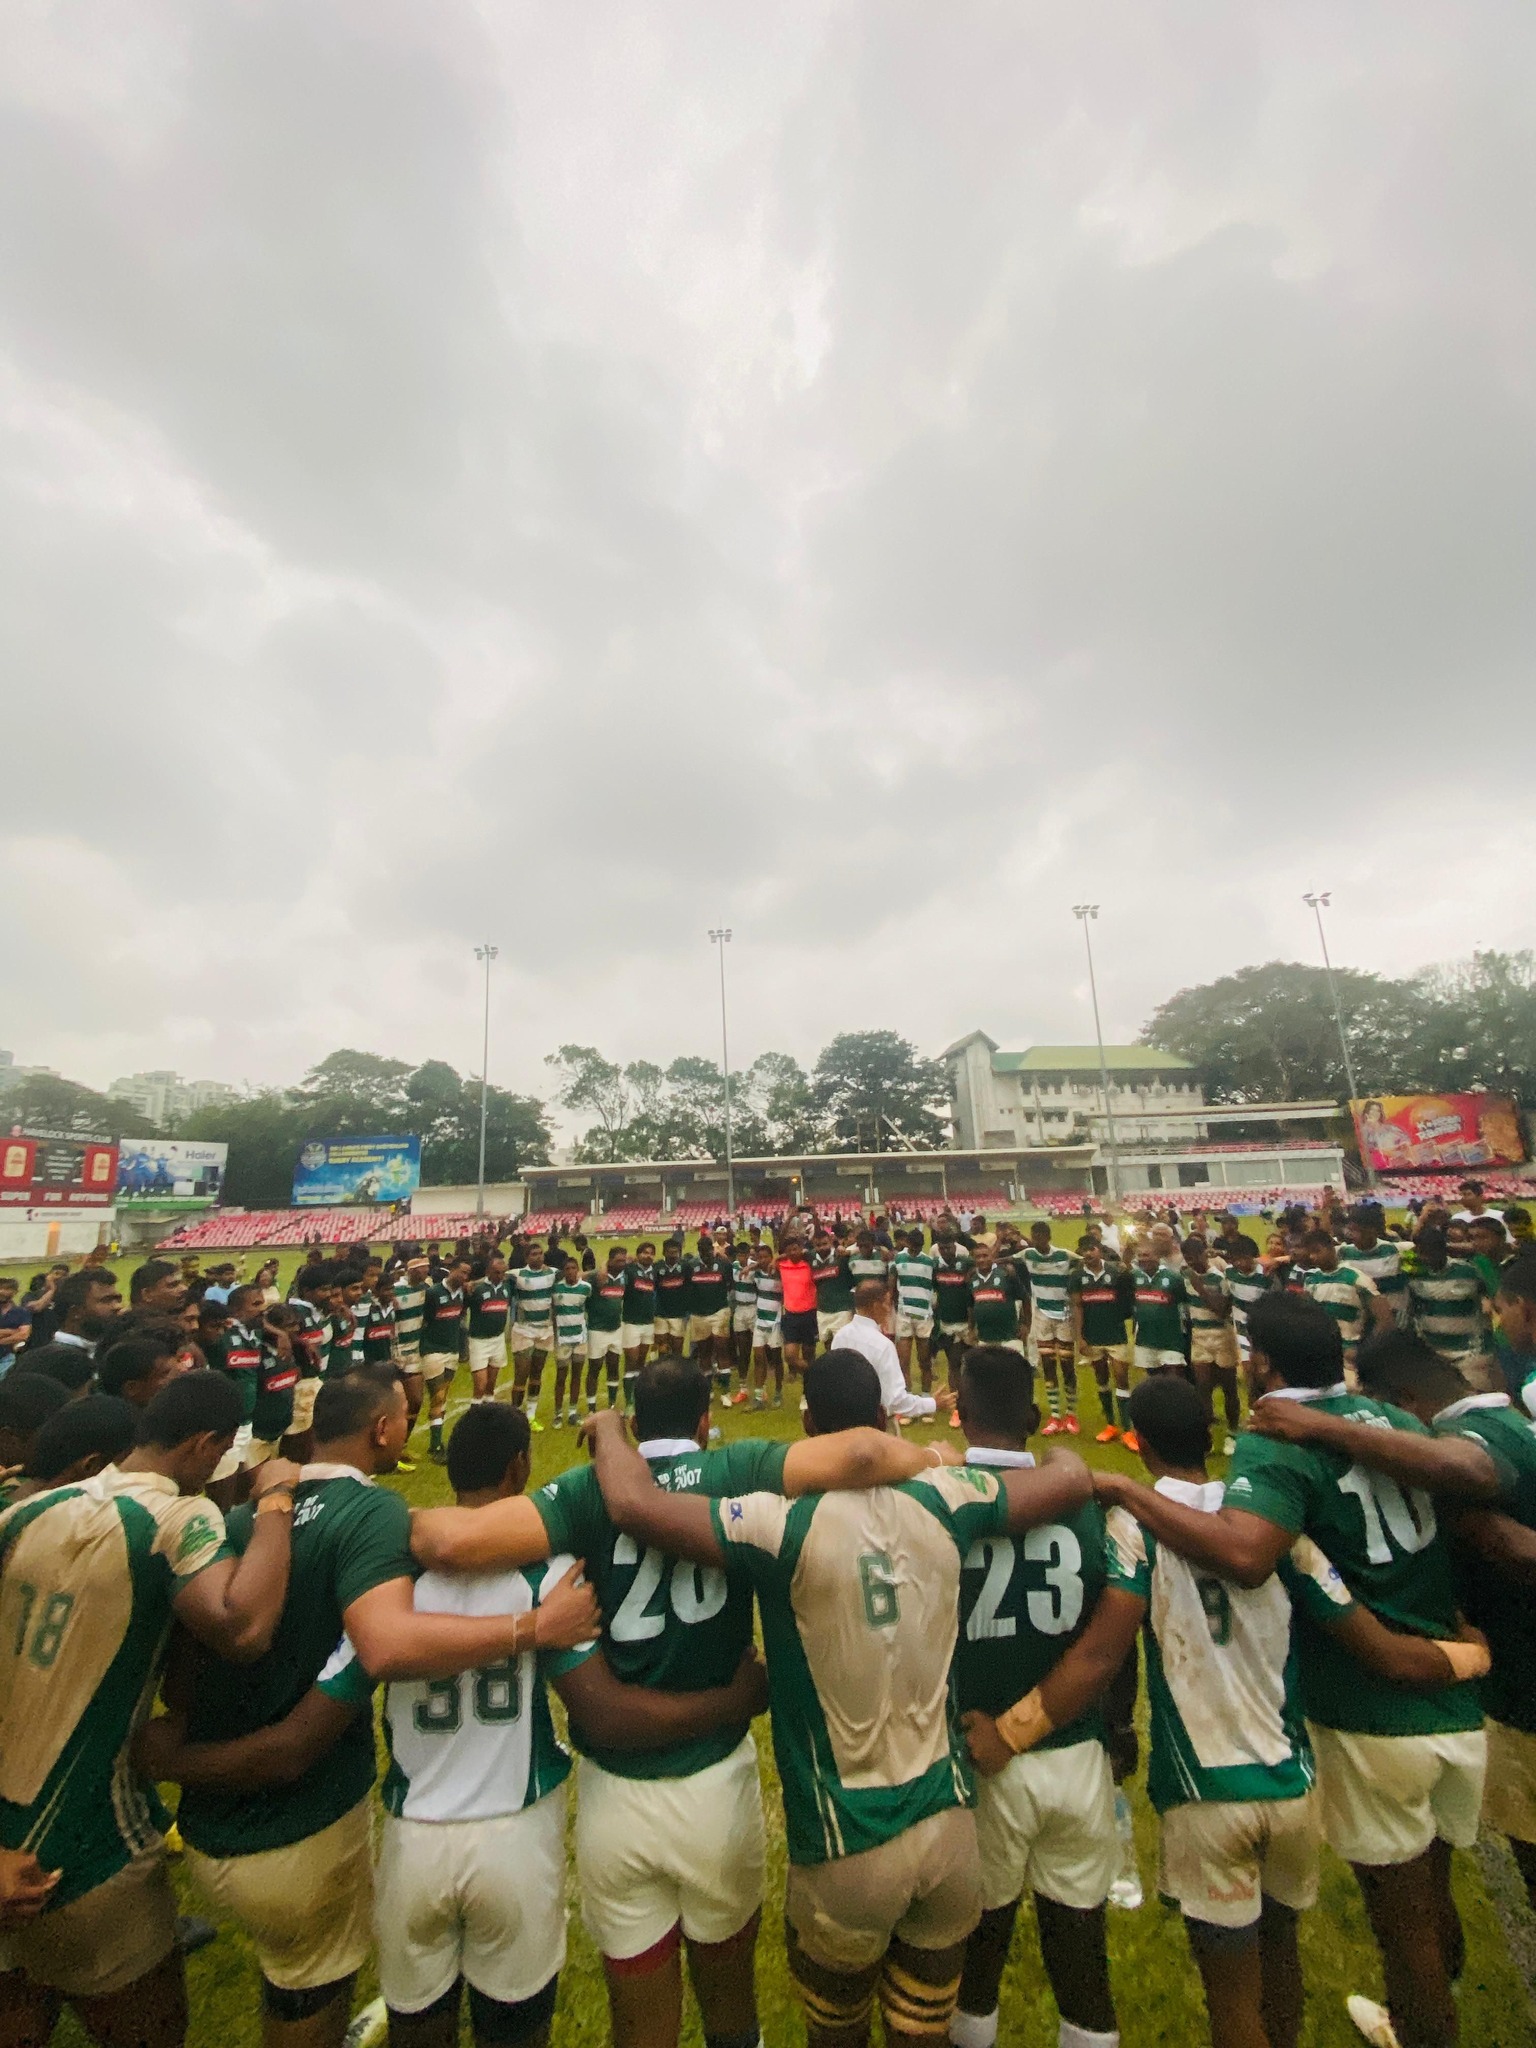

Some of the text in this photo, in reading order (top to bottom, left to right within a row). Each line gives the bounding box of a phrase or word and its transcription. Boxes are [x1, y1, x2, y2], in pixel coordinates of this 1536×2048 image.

[185, 1150, 216, 1160] Haier
[1337, 1464, 1437, 1565] 10
[13, 1583, 76, 1668] 18
[610, 1531, 728, 1642] 20
[858, 1552, 901, 1631] 6
[963, 1523, 1084, 1641] 23
